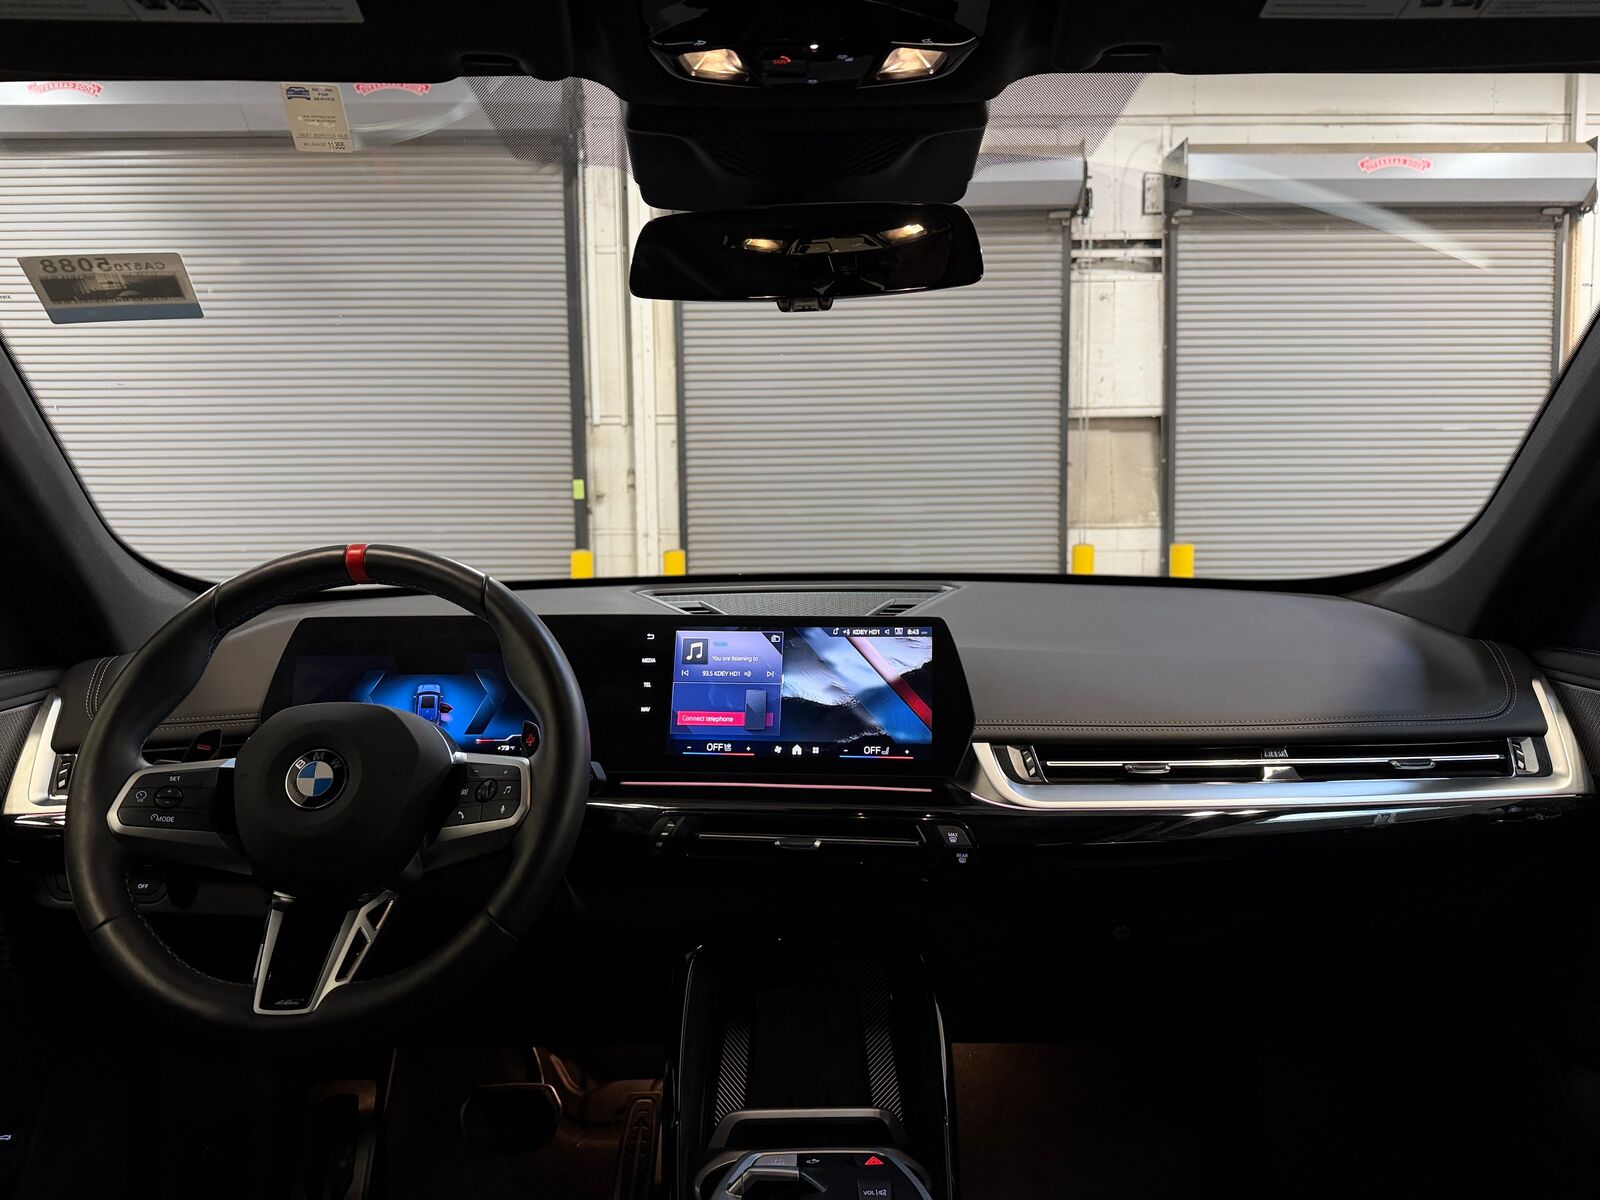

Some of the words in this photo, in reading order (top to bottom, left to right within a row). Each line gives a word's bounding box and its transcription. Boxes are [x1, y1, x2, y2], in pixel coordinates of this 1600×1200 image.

[75, 82, 96, 95] DOOR
[731, 655, 753, 663] listening
[682, 714, 705, 722] Connect
[705, 715, 734, 724] telephone
[706, 742, 724, 752] OFF
[863, 745, 881, 755] OFF
[295, 751, 342, 770] BMW
[156, 815, 175, 823] MODE
